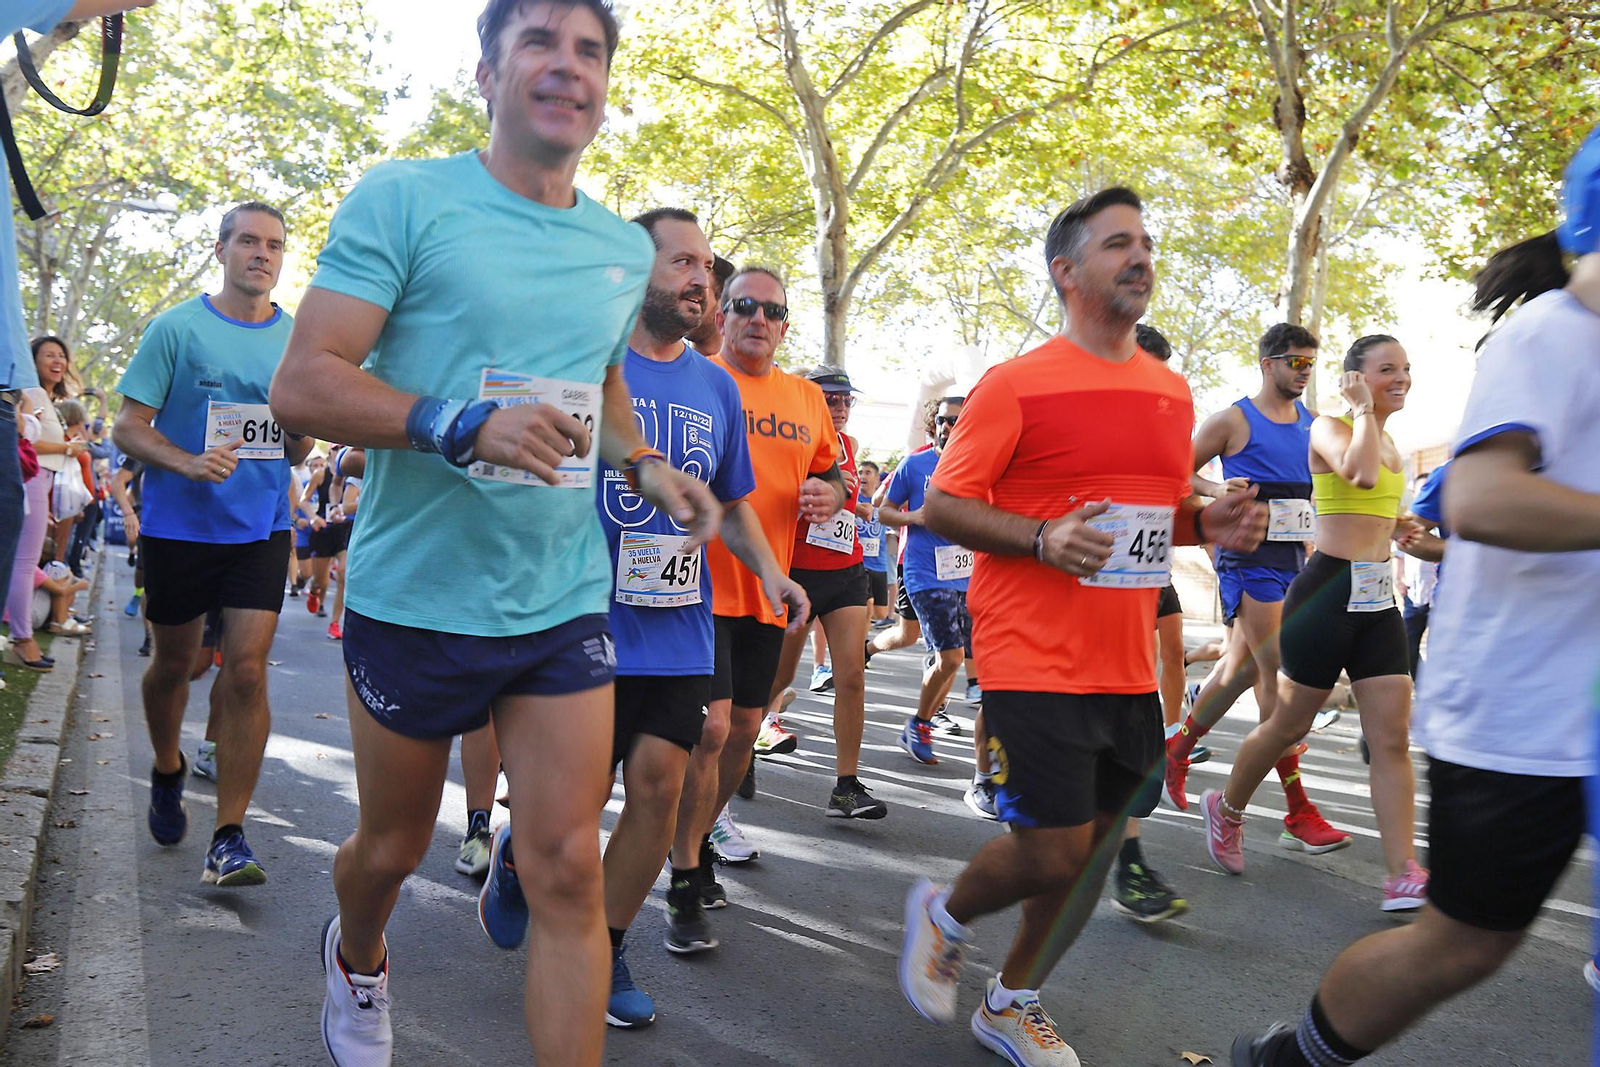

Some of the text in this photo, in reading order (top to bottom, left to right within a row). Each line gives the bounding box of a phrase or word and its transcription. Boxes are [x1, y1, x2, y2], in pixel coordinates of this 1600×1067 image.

[649, 399, 657, 409] A
[243, 419, 281, 443] 619
[604, 469, 627, 478] HUE
[628, 547, 661, 558] 35 VUELTA
[638, 555, 662, 565] HUELVA
[660, 553, 699, 587] 451
